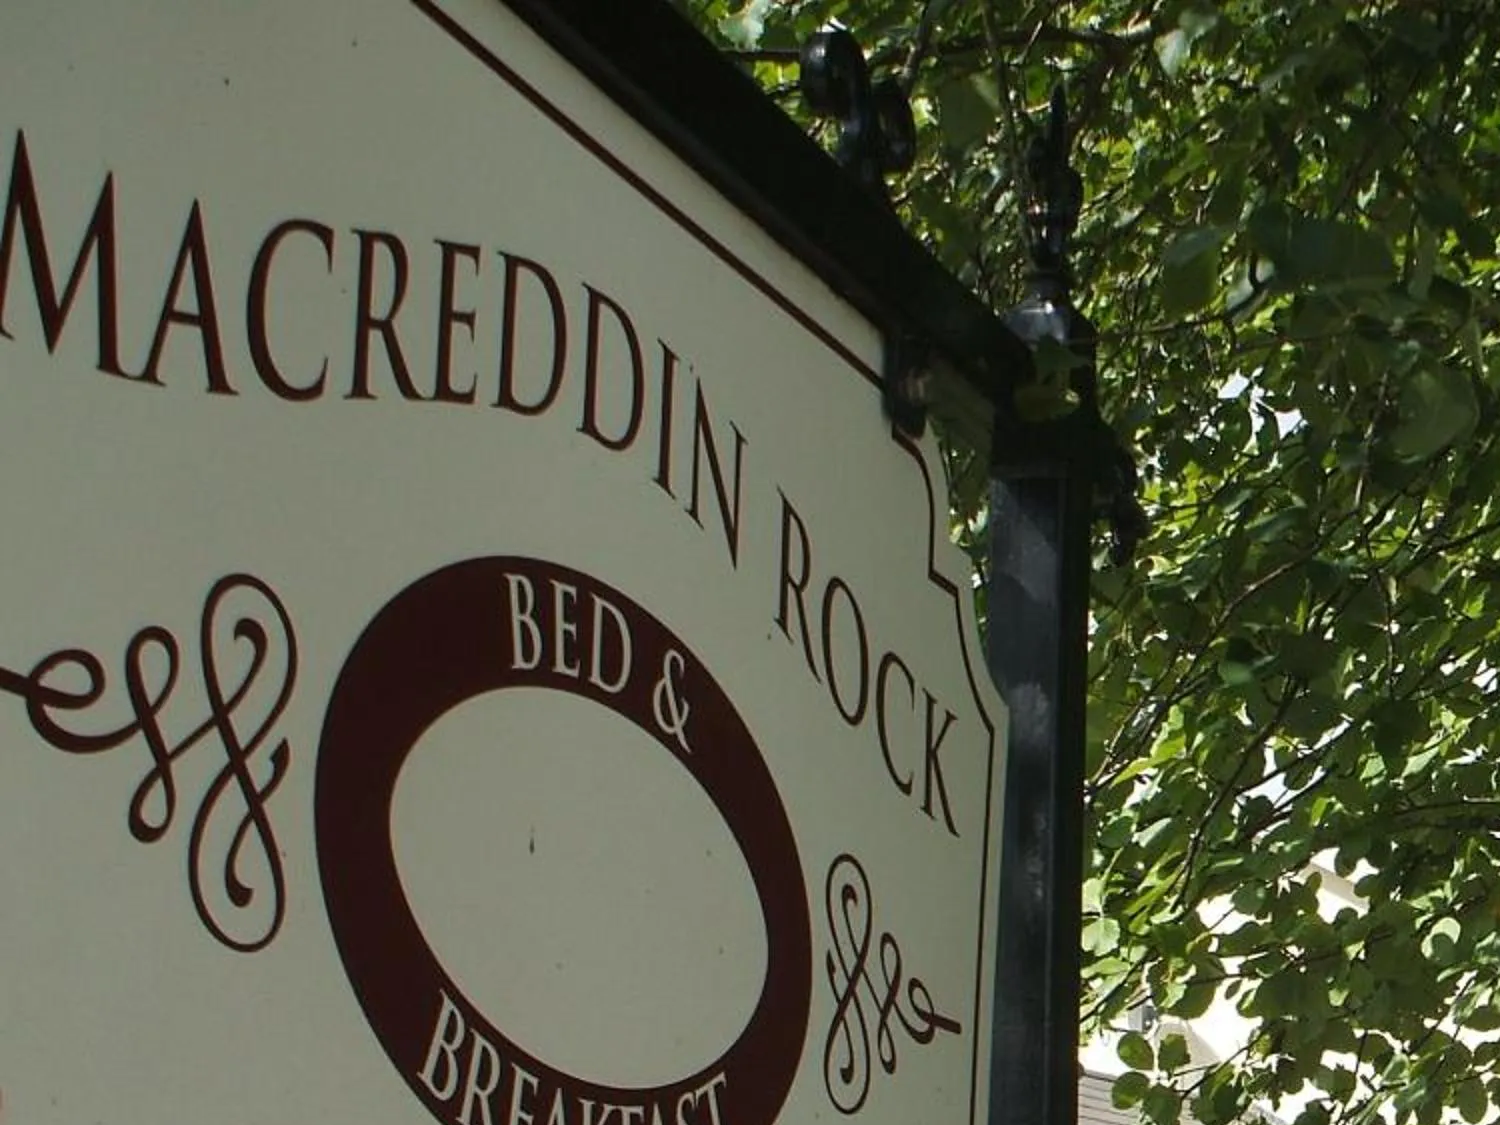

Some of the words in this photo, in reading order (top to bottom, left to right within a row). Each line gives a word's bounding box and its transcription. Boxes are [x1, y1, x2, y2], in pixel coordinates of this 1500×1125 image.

[0, 127, 749, 571] MACREDDIN
[773, 485, 960, 840] ROCK
[502, 571, 633, 694] BED
[652, 648, 694, 754] &
